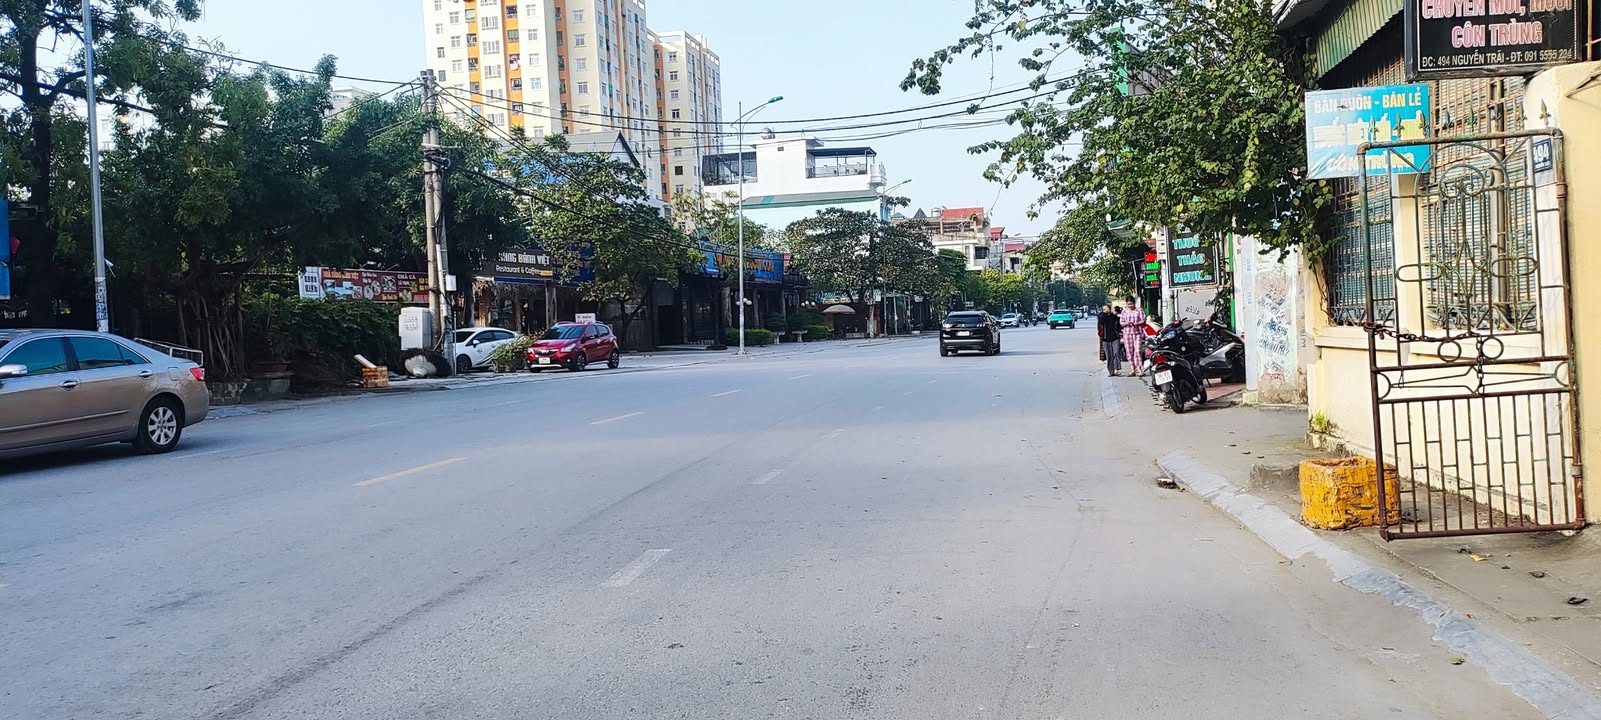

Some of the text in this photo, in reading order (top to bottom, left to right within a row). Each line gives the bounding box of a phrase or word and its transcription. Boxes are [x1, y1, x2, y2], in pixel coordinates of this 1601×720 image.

[1451, 21, 1486, 48] CÔN
[1422, 56, 1436, 67] ĐC:
[1437, 55, 1450, 66] 494
[1511, 51, 1523, 62] ĐT:
[1524, 50, 1537, 62] 091
[1539, 49, 1557, 61] 5555
[1314, 97, 1338, 113] BÁN
[1382, 91, 1405, 108] BÁN
[1409, 86, 1422, 106] LẺ
